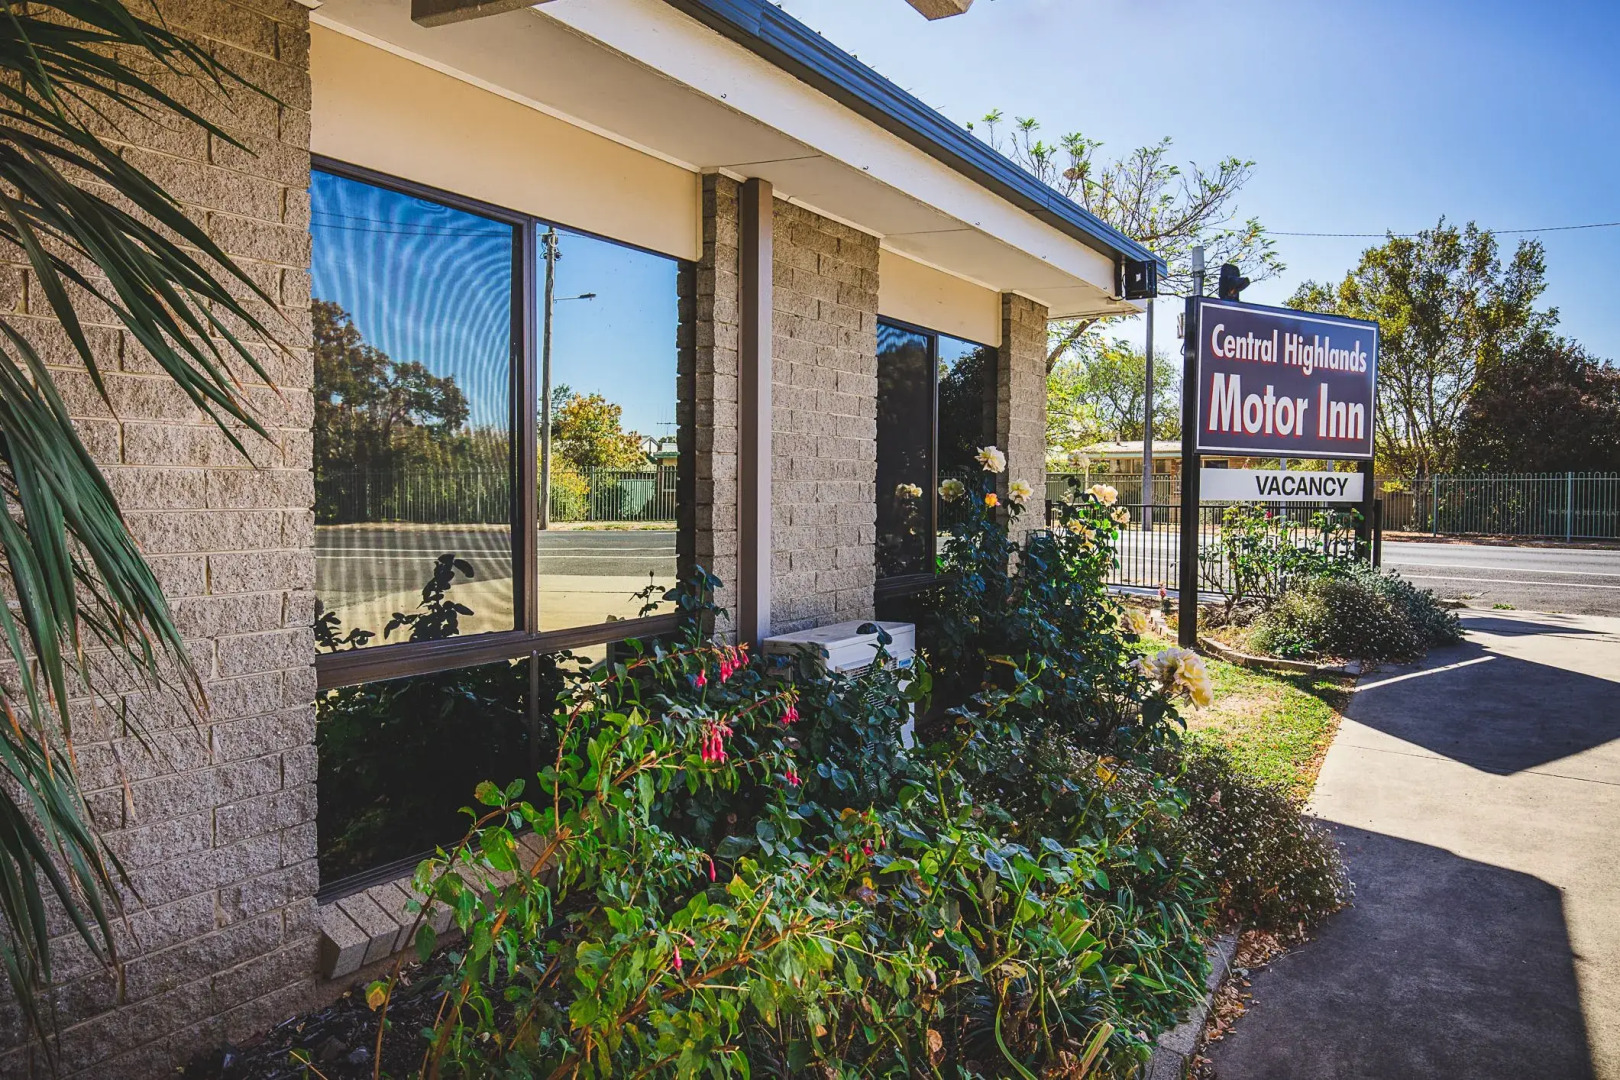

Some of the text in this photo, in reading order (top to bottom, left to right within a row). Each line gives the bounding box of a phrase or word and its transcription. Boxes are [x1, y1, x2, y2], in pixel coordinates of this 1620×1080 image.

[1211, 323, 1367, 376] Central Highlands
[1208, 372, 1365, 440] Motor Inn
[1255, 475, 1349, 497] VACANCY
